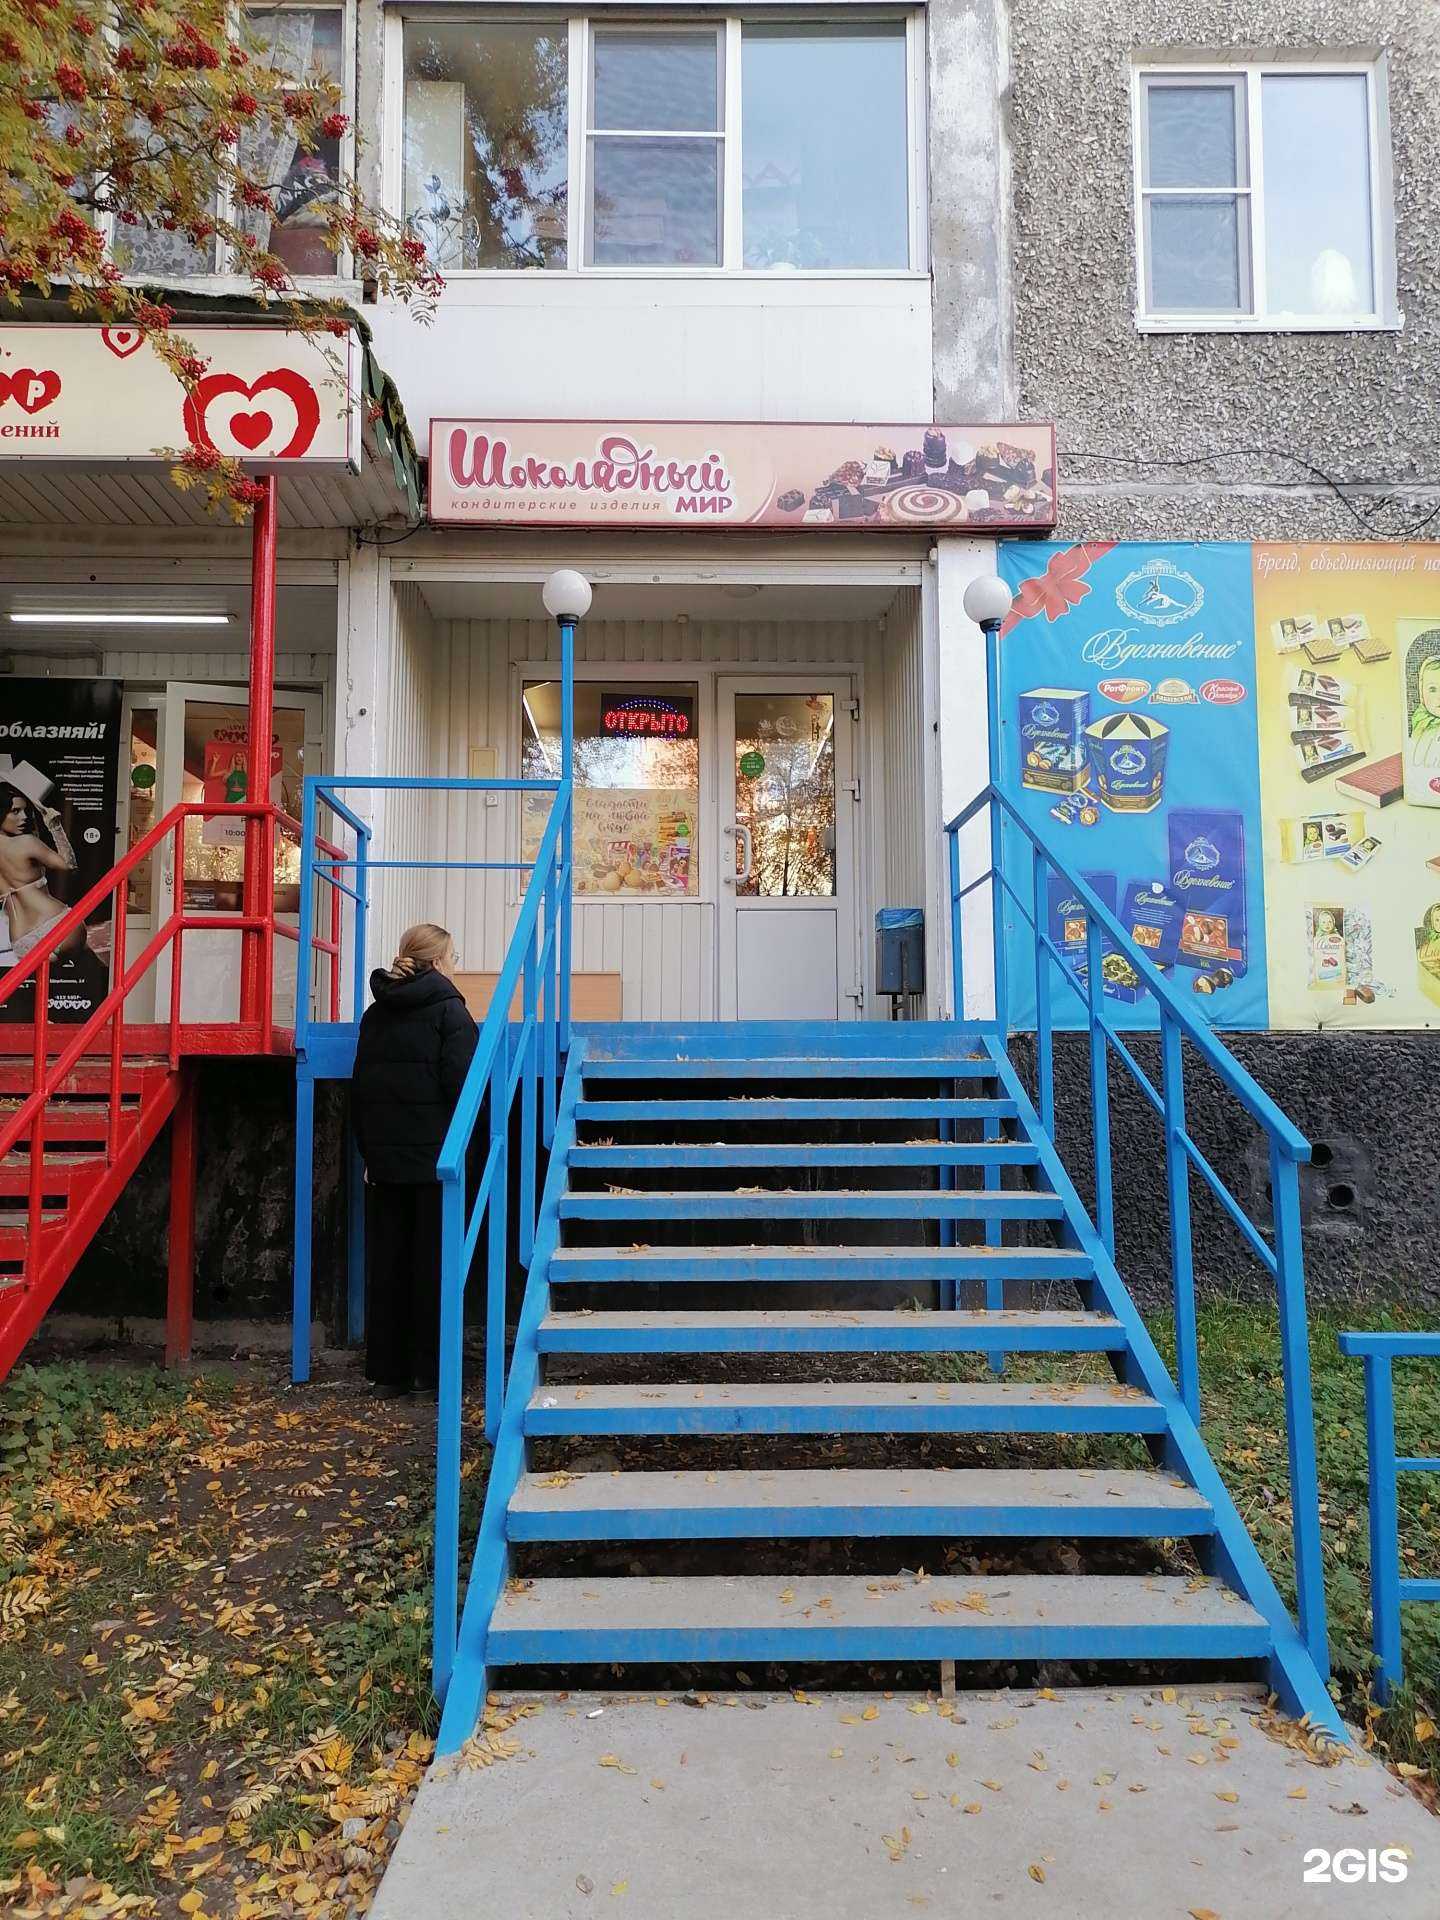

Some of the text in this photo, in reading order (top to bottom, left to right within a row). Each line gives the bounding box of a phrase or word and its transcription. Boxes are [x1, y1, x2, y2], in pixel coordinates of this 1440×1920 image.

[449, 428, 731, 493] Шоколадный
[450, 499, 661, 512] кондитерские изделия
[675, 496, 733, 514] МИР
[1256, 552, 1301, 578] Бренд,
[1310, 549, 1416, 576] объединяющий
[1081, 628, 1238, 671] Вдохновение
[0, 721, 107, 739] облазняй!
[604, 711, 689, 733] ОТКРЫТО
